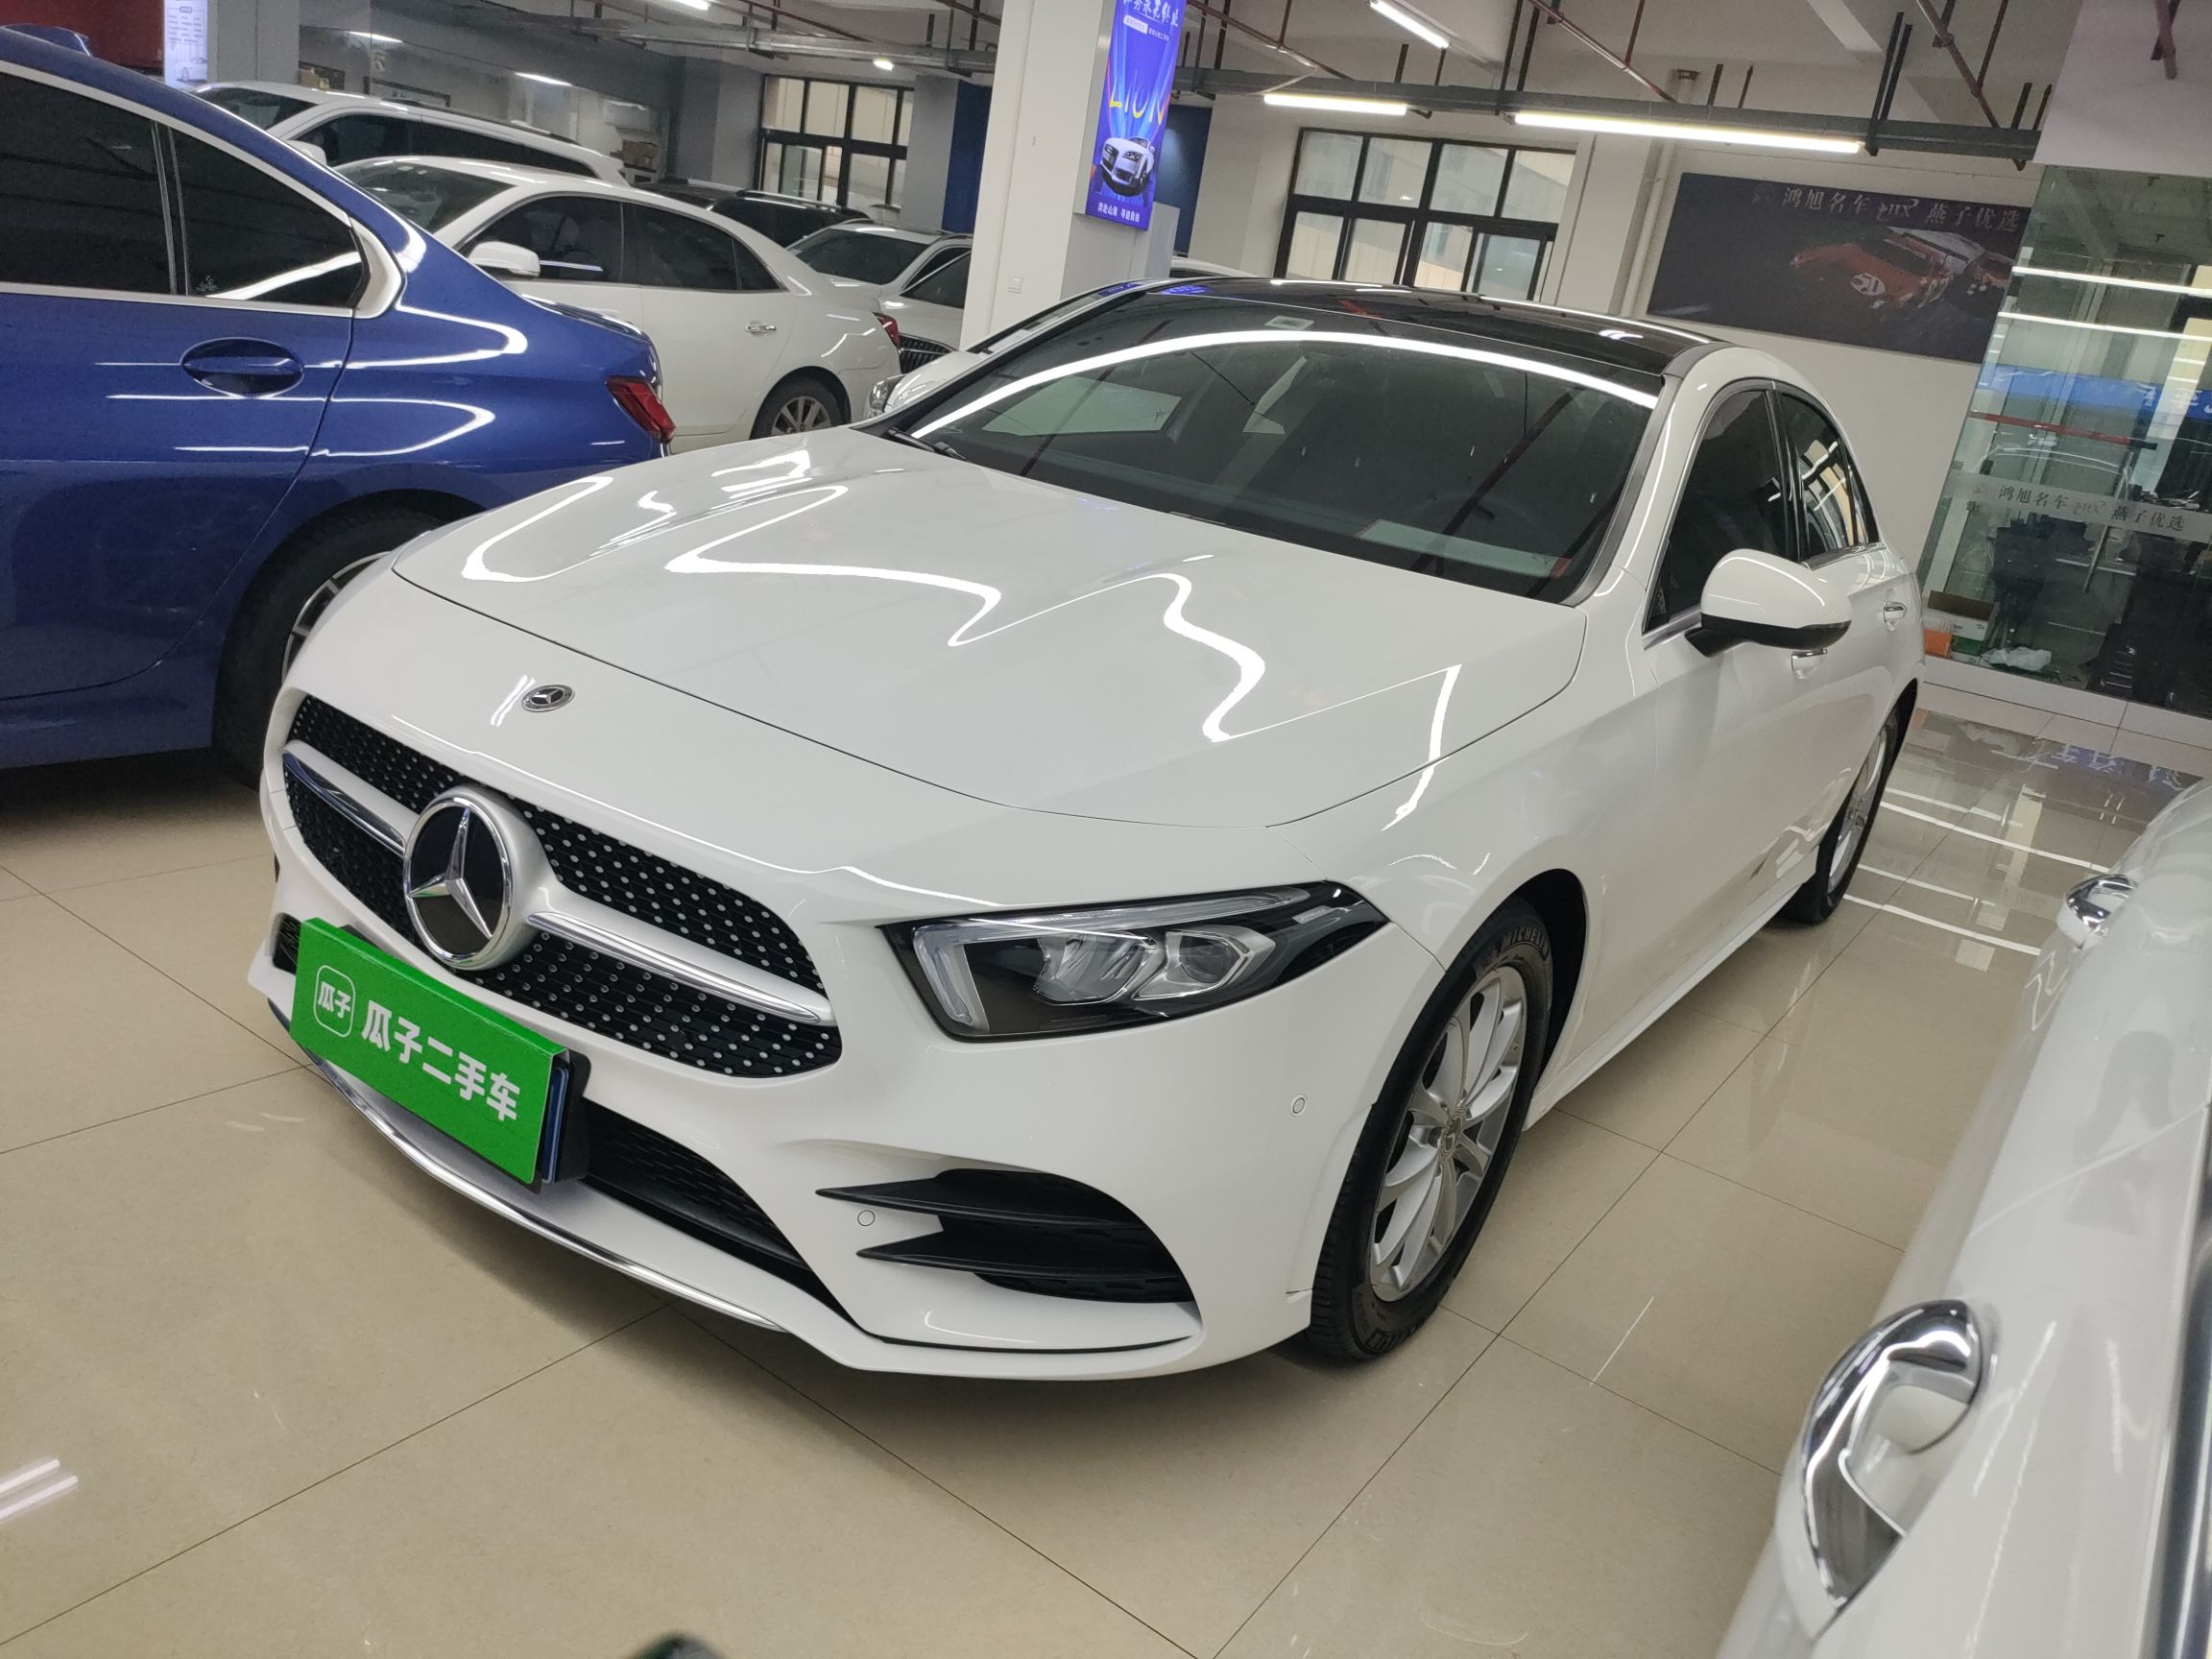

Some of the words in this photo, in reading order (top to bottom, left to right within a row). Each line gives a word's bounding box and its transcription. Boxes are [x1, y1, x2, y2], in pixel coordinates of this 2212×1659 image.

[1925, 203, 2020, 232] 燕子优选
[317, 980, 352, 1019] 瓜子
[360, 999, 521, 1121] 瓜子二手车
